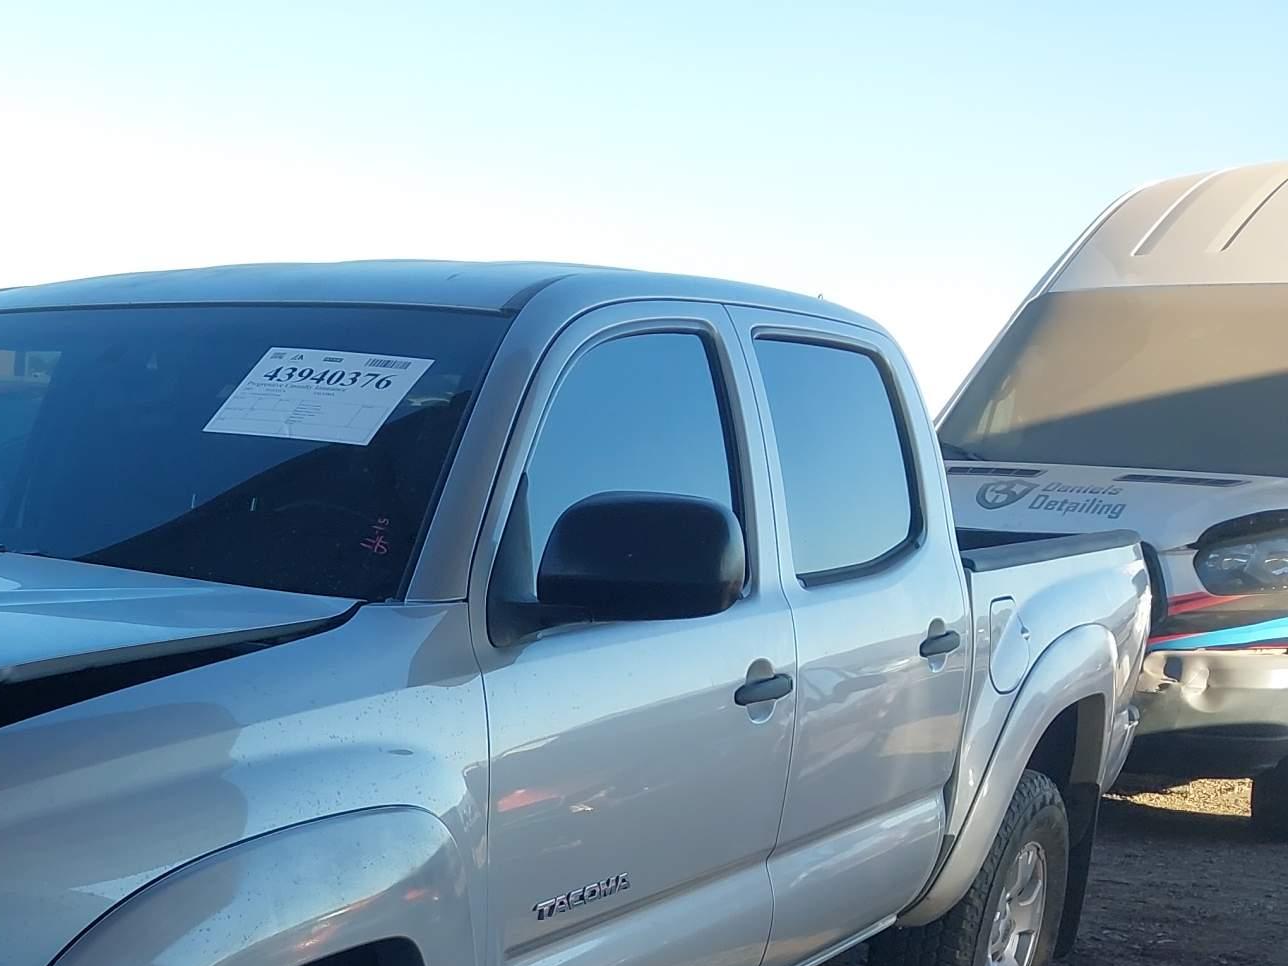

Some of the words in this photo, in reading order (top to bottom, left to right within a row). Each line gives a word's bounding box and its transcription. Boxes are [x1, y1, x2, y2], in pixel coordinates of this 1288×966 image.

[263, 366, 397, 390] 43940376
[1041, 481, 1125, 496] Daniels
[1028, 494, 1126, 519] Detailing
[532, 872, 630, 920] TACOMA
